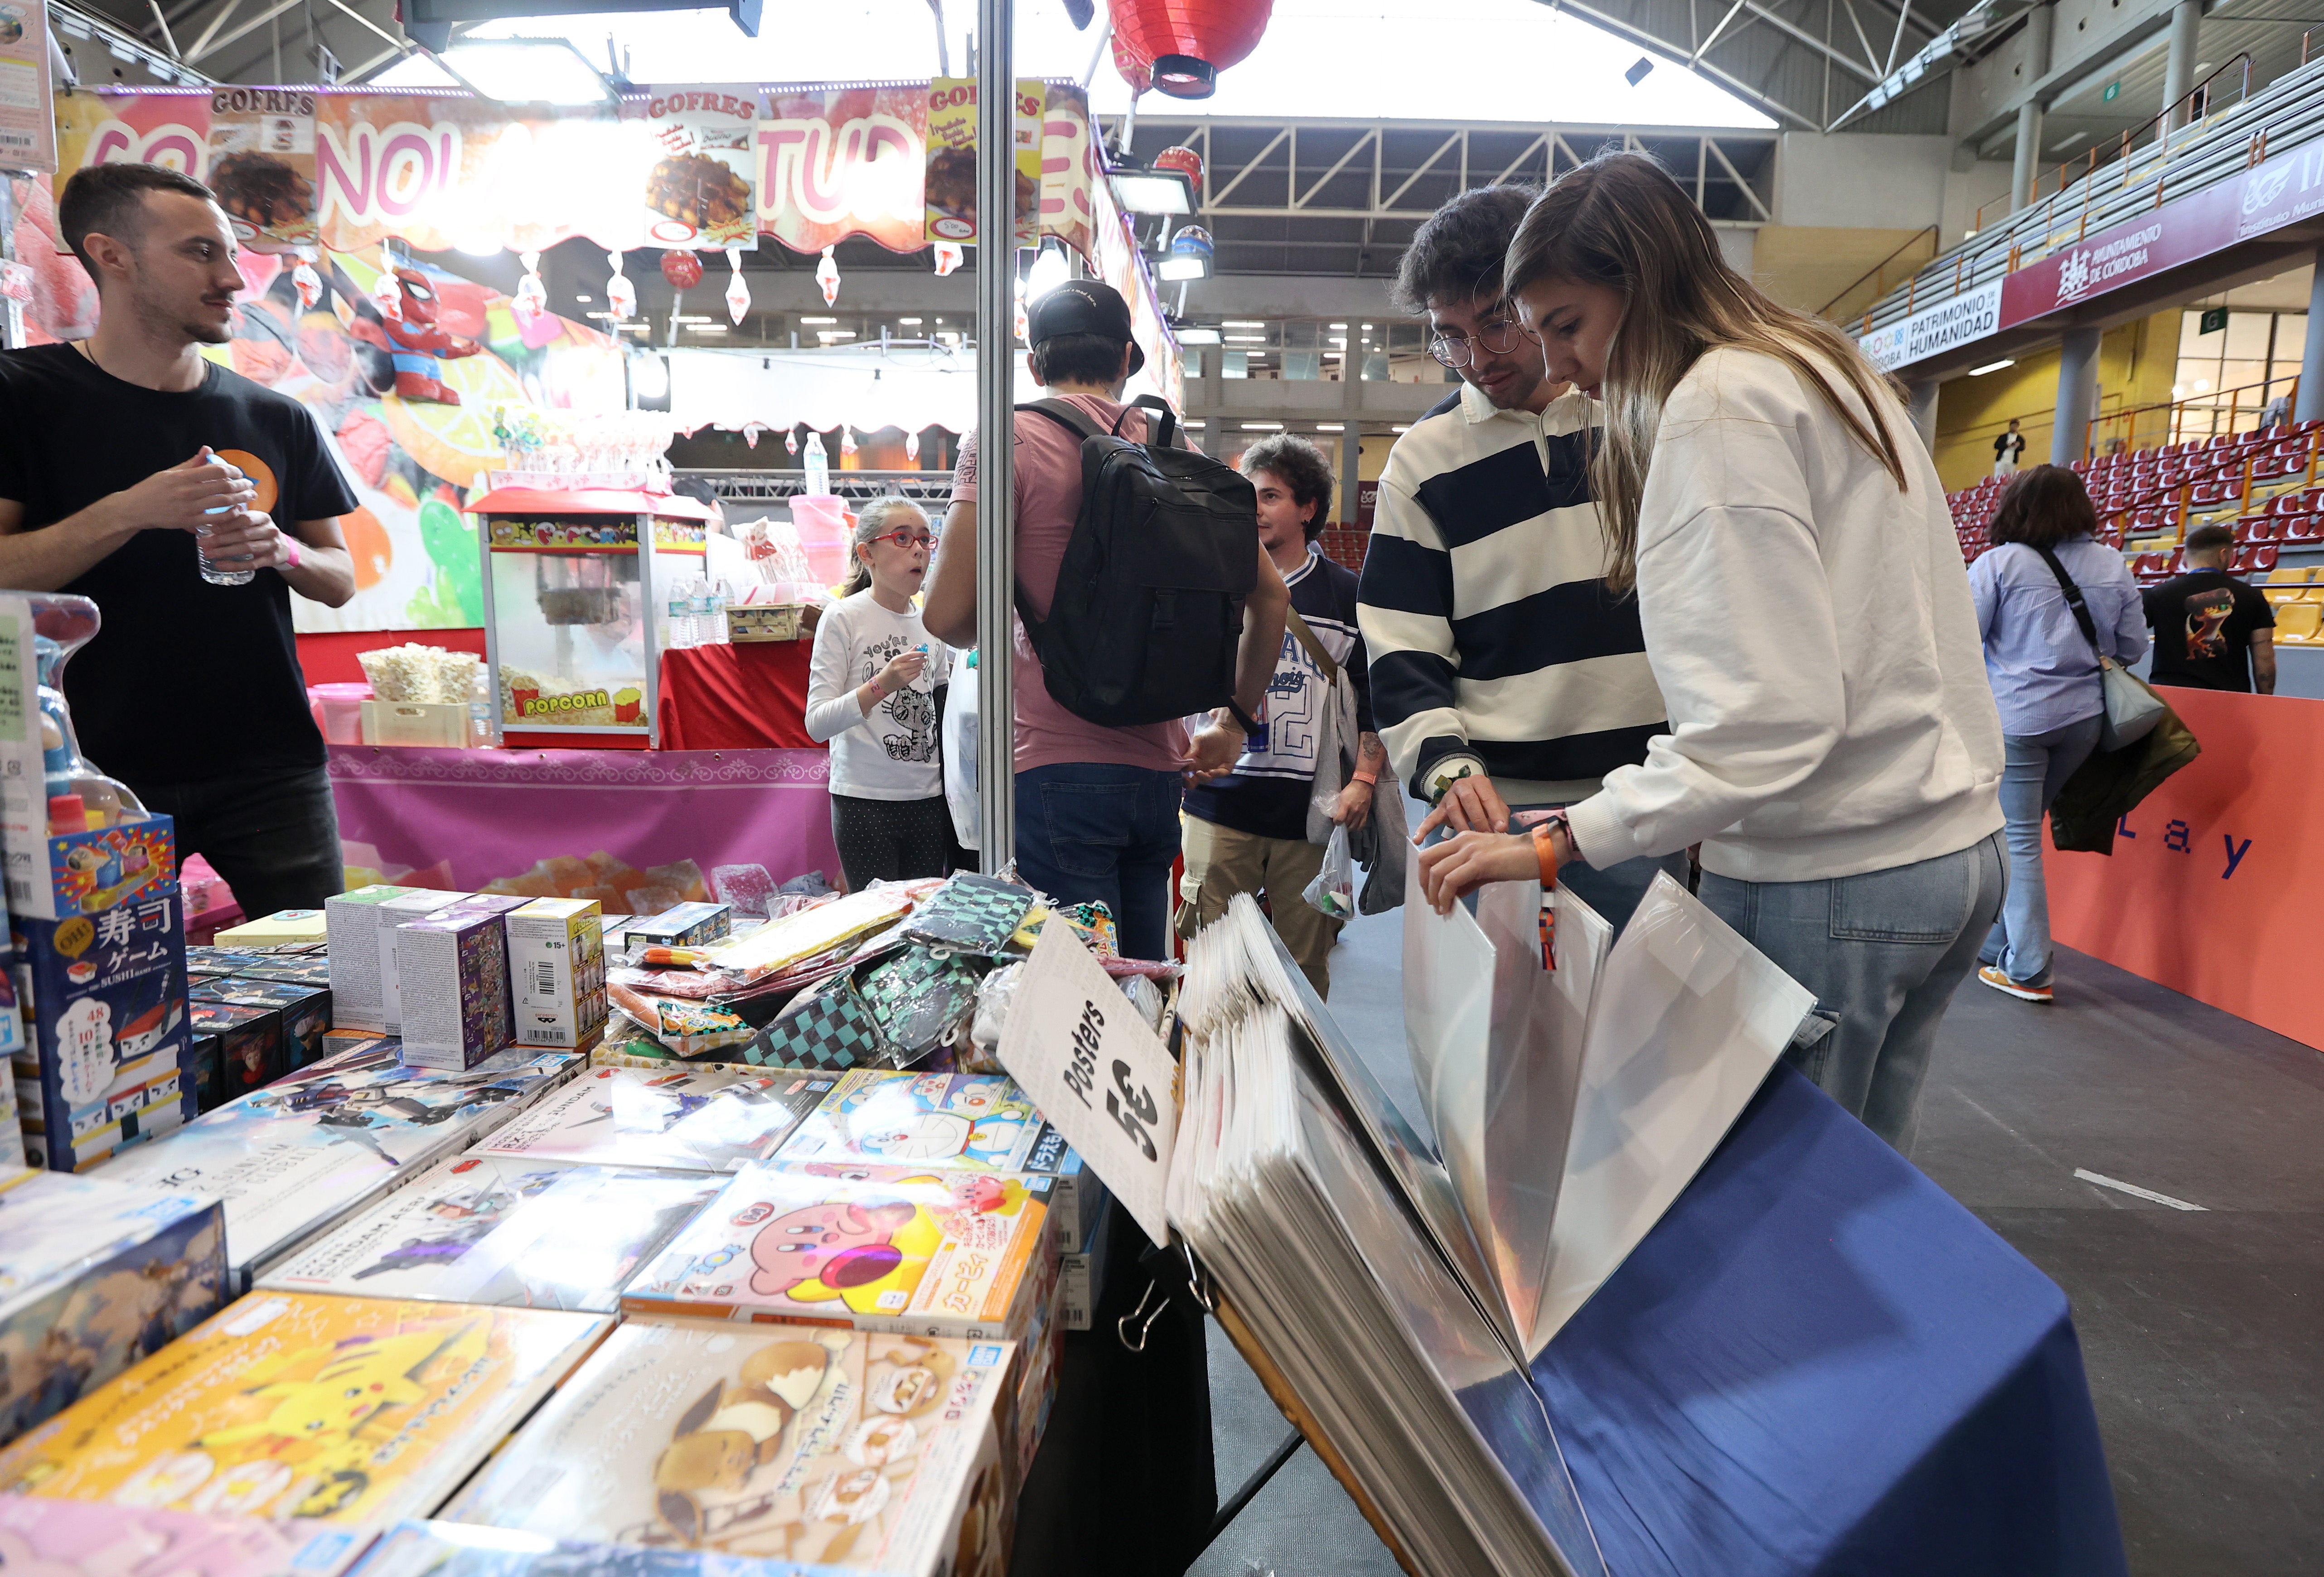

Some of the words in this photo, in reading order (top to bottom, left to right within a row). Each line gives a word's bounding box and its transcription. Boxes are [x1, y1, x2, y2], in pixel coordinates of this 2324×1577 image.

[649, 92, 755, 119] GOFRES
[2091, 223, 2162, 266] AYUNTAMIENTO
[2089, 266, 2102, 284] DE
[1912, 295, 1985, 337] PATRIMONIO
[2207, 312, 2219, 329] G
[1909, 311, 1993, 358] HUMANIDAD
[863, 634, 908, 658] YOU'RE
[524, 689, 608, 716] POPCORN
[59, 923, 91, 950] OH!
[97, 898, 171, 948] 寿司
[107, 941, 168, 974] ゲーム
[101, 968, 135, 988] SUSHI
[87, 1006, 104, 1021] 48
[79, 1030, 93, 1044] 10
[1062, 1000, 1105, 1112] Posters
[1106, 1059, 1158, 1163] 5€
[492, 1127, 522, 1150] MOBILE
[522, 1114, 539, 1128] SUIT
[944, 1253, 987, 1313] カービィ
